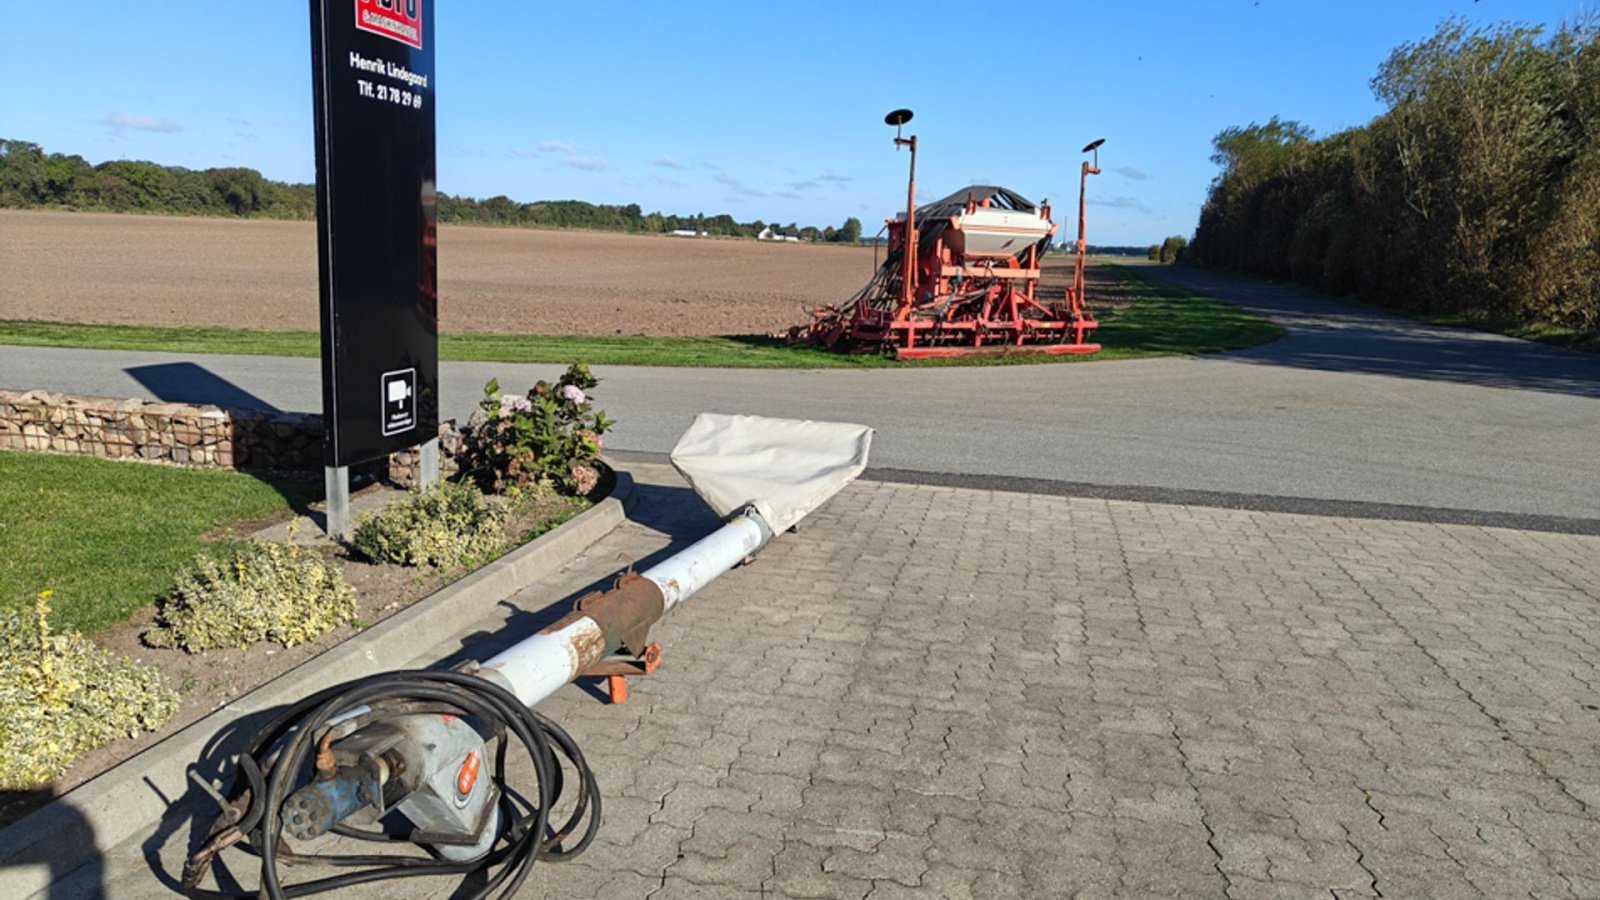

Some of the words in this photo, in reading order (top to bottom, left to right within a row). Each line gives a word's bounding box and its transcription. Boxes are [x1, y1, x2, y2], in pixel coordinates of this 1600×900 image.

[349, 51, 386, 75] Henrik
[387, 61, 428, 88] Lindegaard
[357, 80, 375, 98] Tlf.
[377, 84, 388, 101] 21
[389, 87, 401, 104] 78
[401, 90, 412, 106] 29
